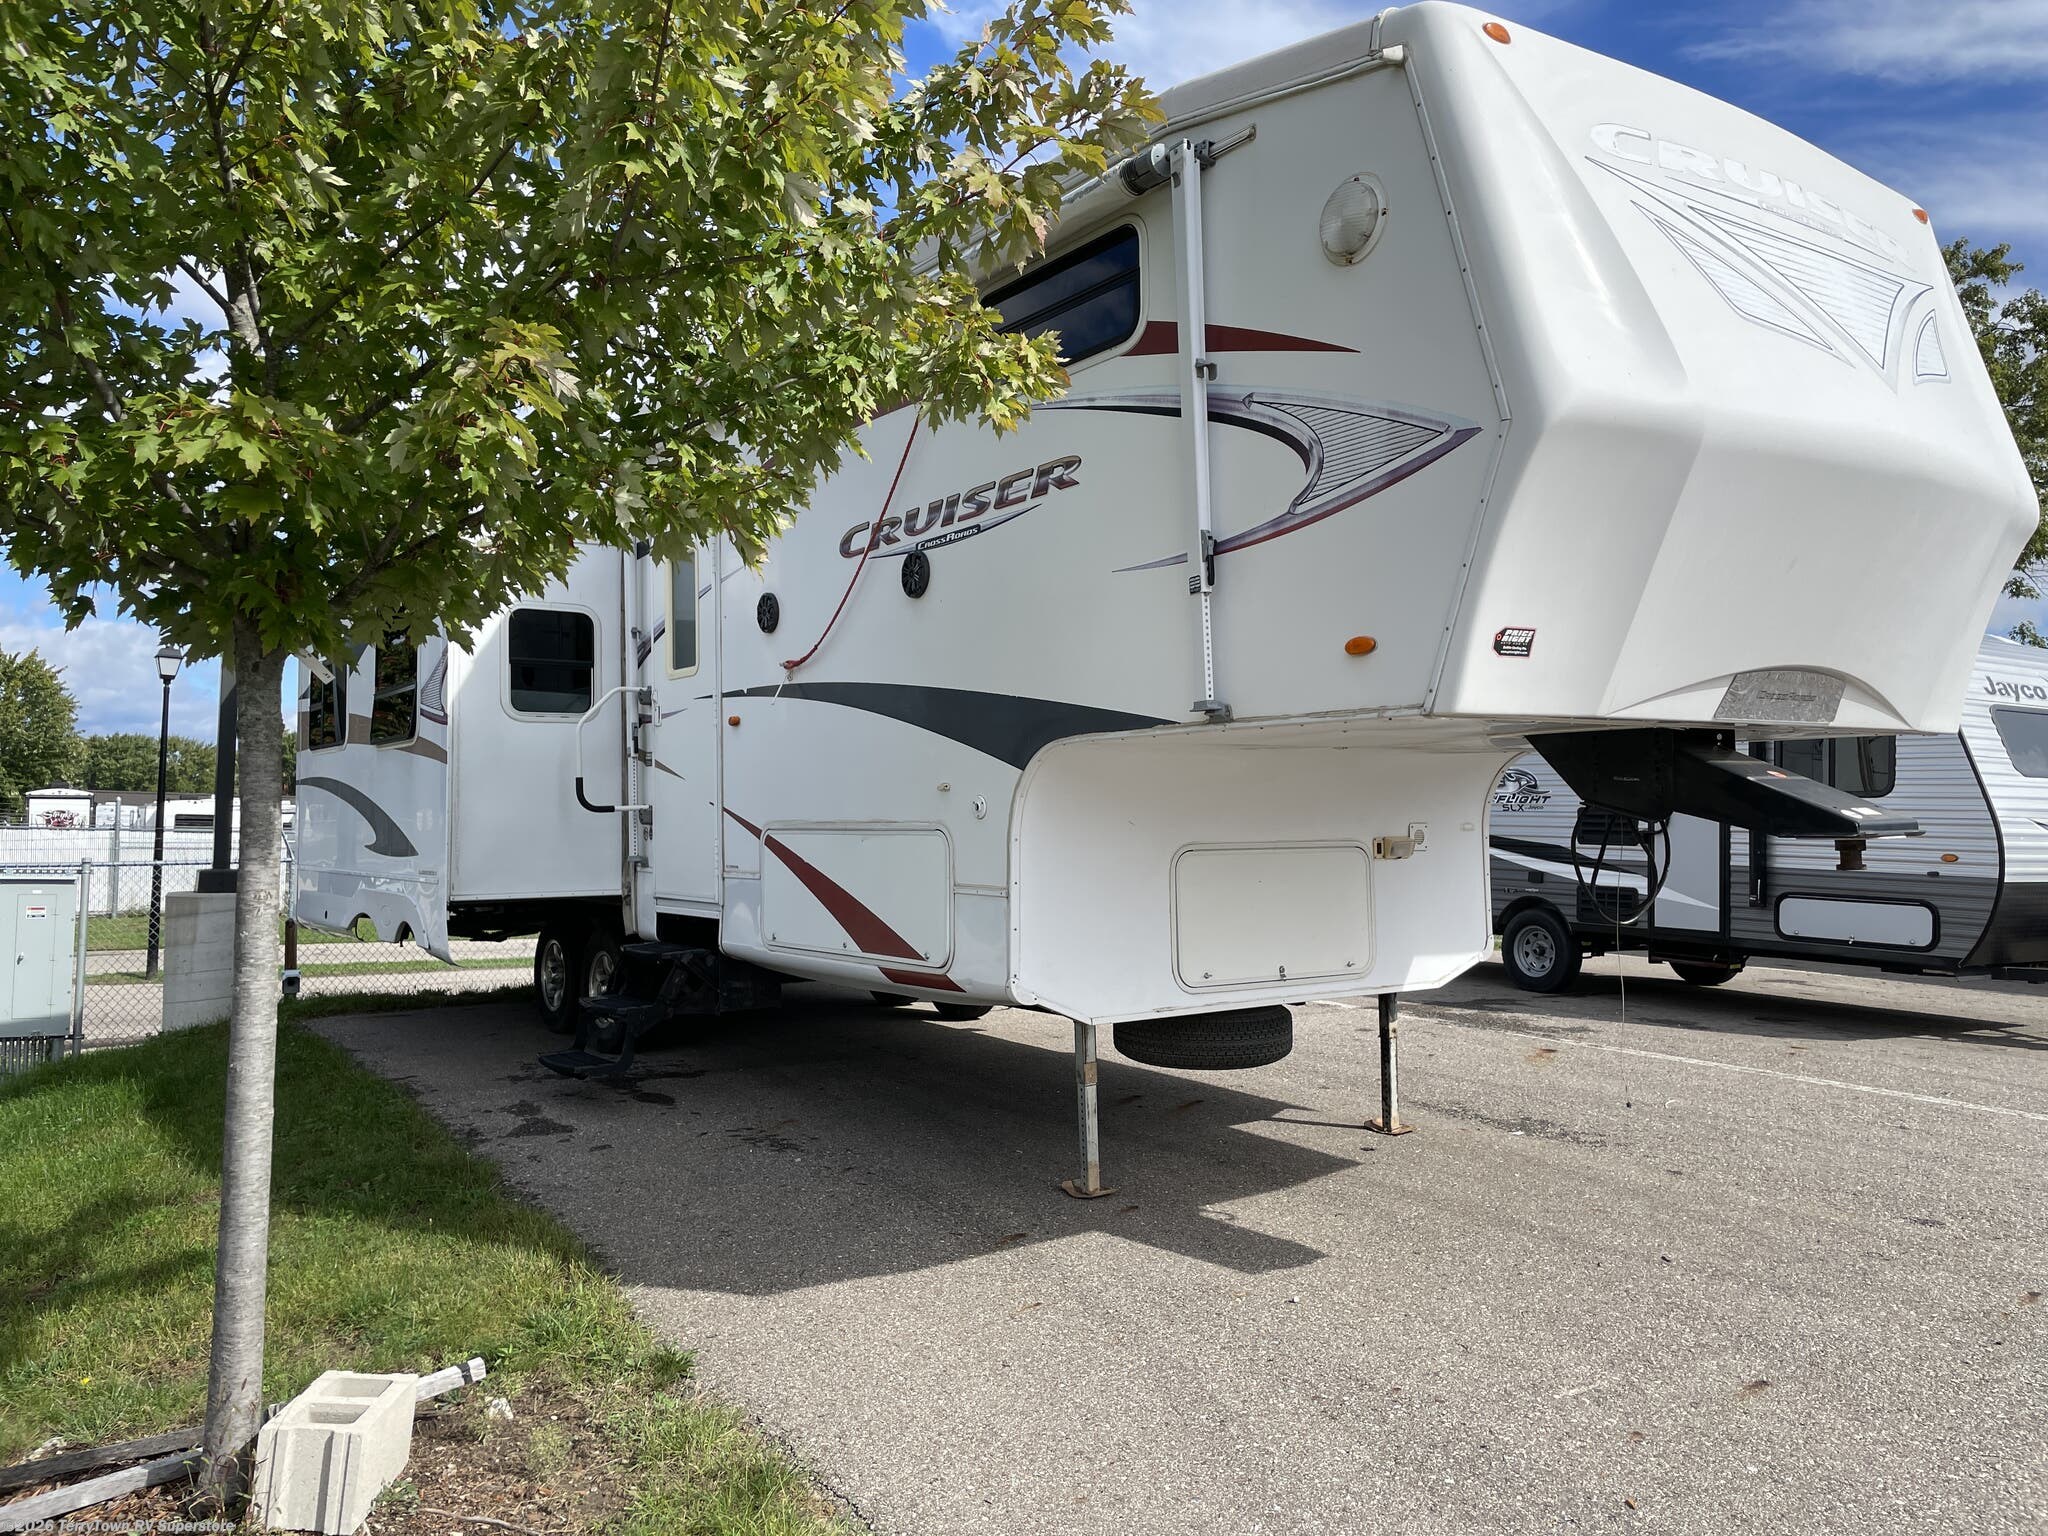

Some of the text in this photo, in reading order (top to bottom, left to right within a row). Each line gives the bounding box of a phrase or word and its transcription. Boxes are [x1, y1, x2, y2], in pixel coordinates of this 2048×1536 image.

[839, 454, 1082, 559] CRUISER
[1504, 629, 1535, 637] PRICE
[1501, 635, 1531, 643] RIGHT
[1983, 675, 2048, 702] Jayco
[1495, 794, 1551, 804] FLIGHT
[1502, 803, 1525, 812] SLX
